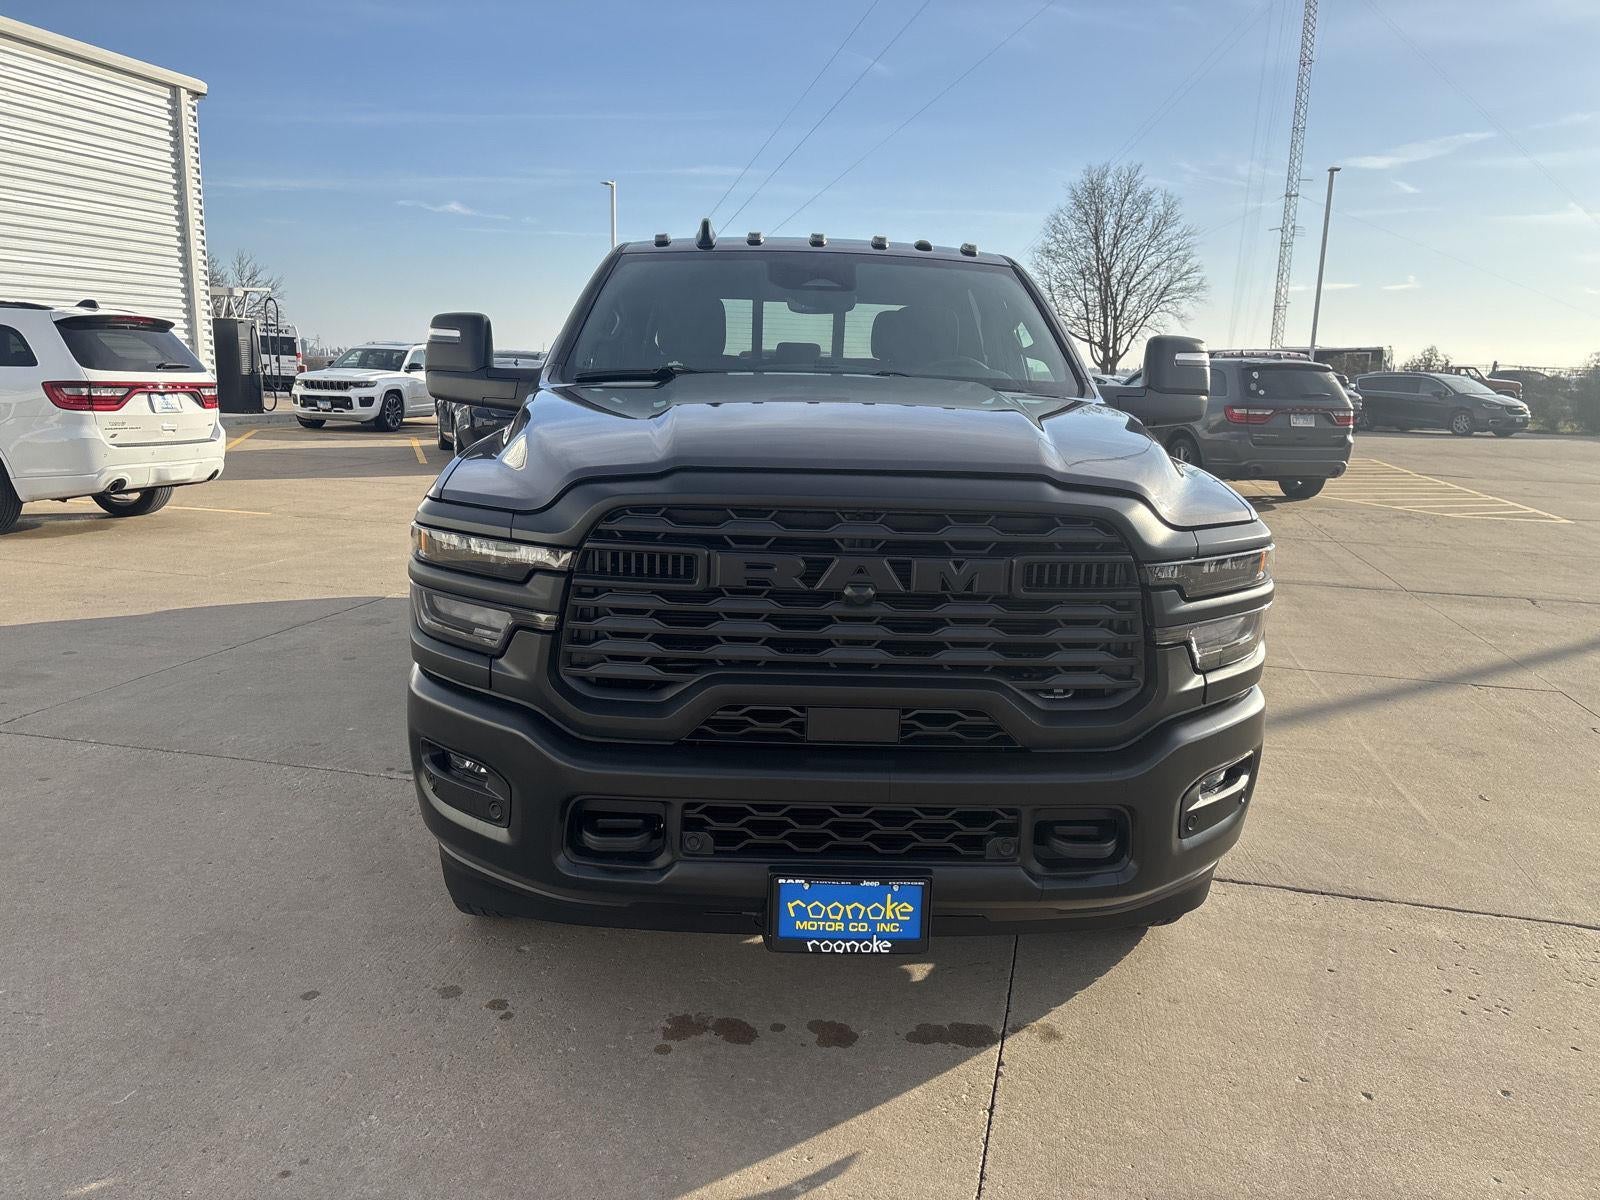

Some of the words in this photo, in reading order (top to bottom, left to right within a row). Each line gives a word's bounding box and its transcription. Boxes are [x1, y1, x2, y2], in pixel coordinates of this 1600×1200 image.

[715, 549, 1010, 594] RAM
[787, 893, 914, 921] roanoke
[795, 920, 845, 932] MOTOR
[849, 921, 872, 933] CO.
[877, 922, 903, 933] INC.
[806, 934, 892, 954] roanoke
